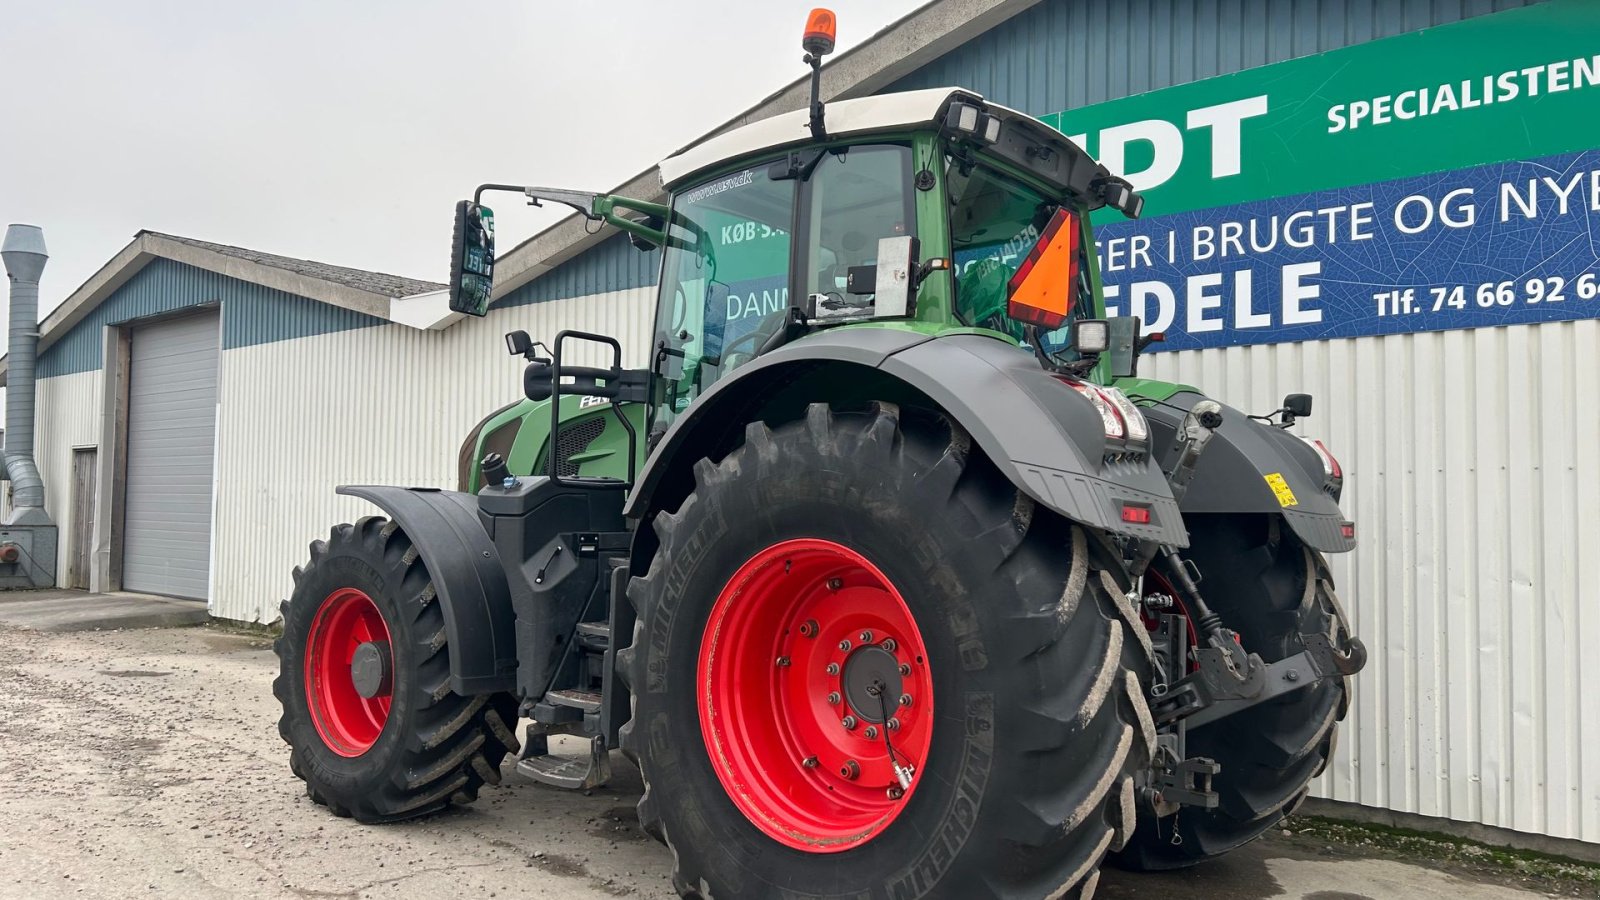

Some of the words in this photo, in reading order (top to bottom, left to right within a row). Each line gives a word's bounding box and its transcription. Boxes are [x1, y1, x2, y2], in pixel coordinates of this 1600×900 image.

[1327, 54, 1600, 133] SPECIALISTEN
[1069, 94, 1268, 193] DT
[1168, 230, 1175, 264] I
[1193, 201, 1374, 261] BRUGTE
[1394, 187, 1475, 234] OG
[726, 287, 788, 320] DAN
[1373, 288, 1421, 317] Tlf.
[1430, 285, 1466, 312] 74
[1476, 281, 1515, 307] 66
[1525, 276, 1565, 304] 92
[1576, 273, 1600, 300] 6
[651, 510, 723, 655] MICHELIN
[893, 743, 991, 900] MICHELIN
